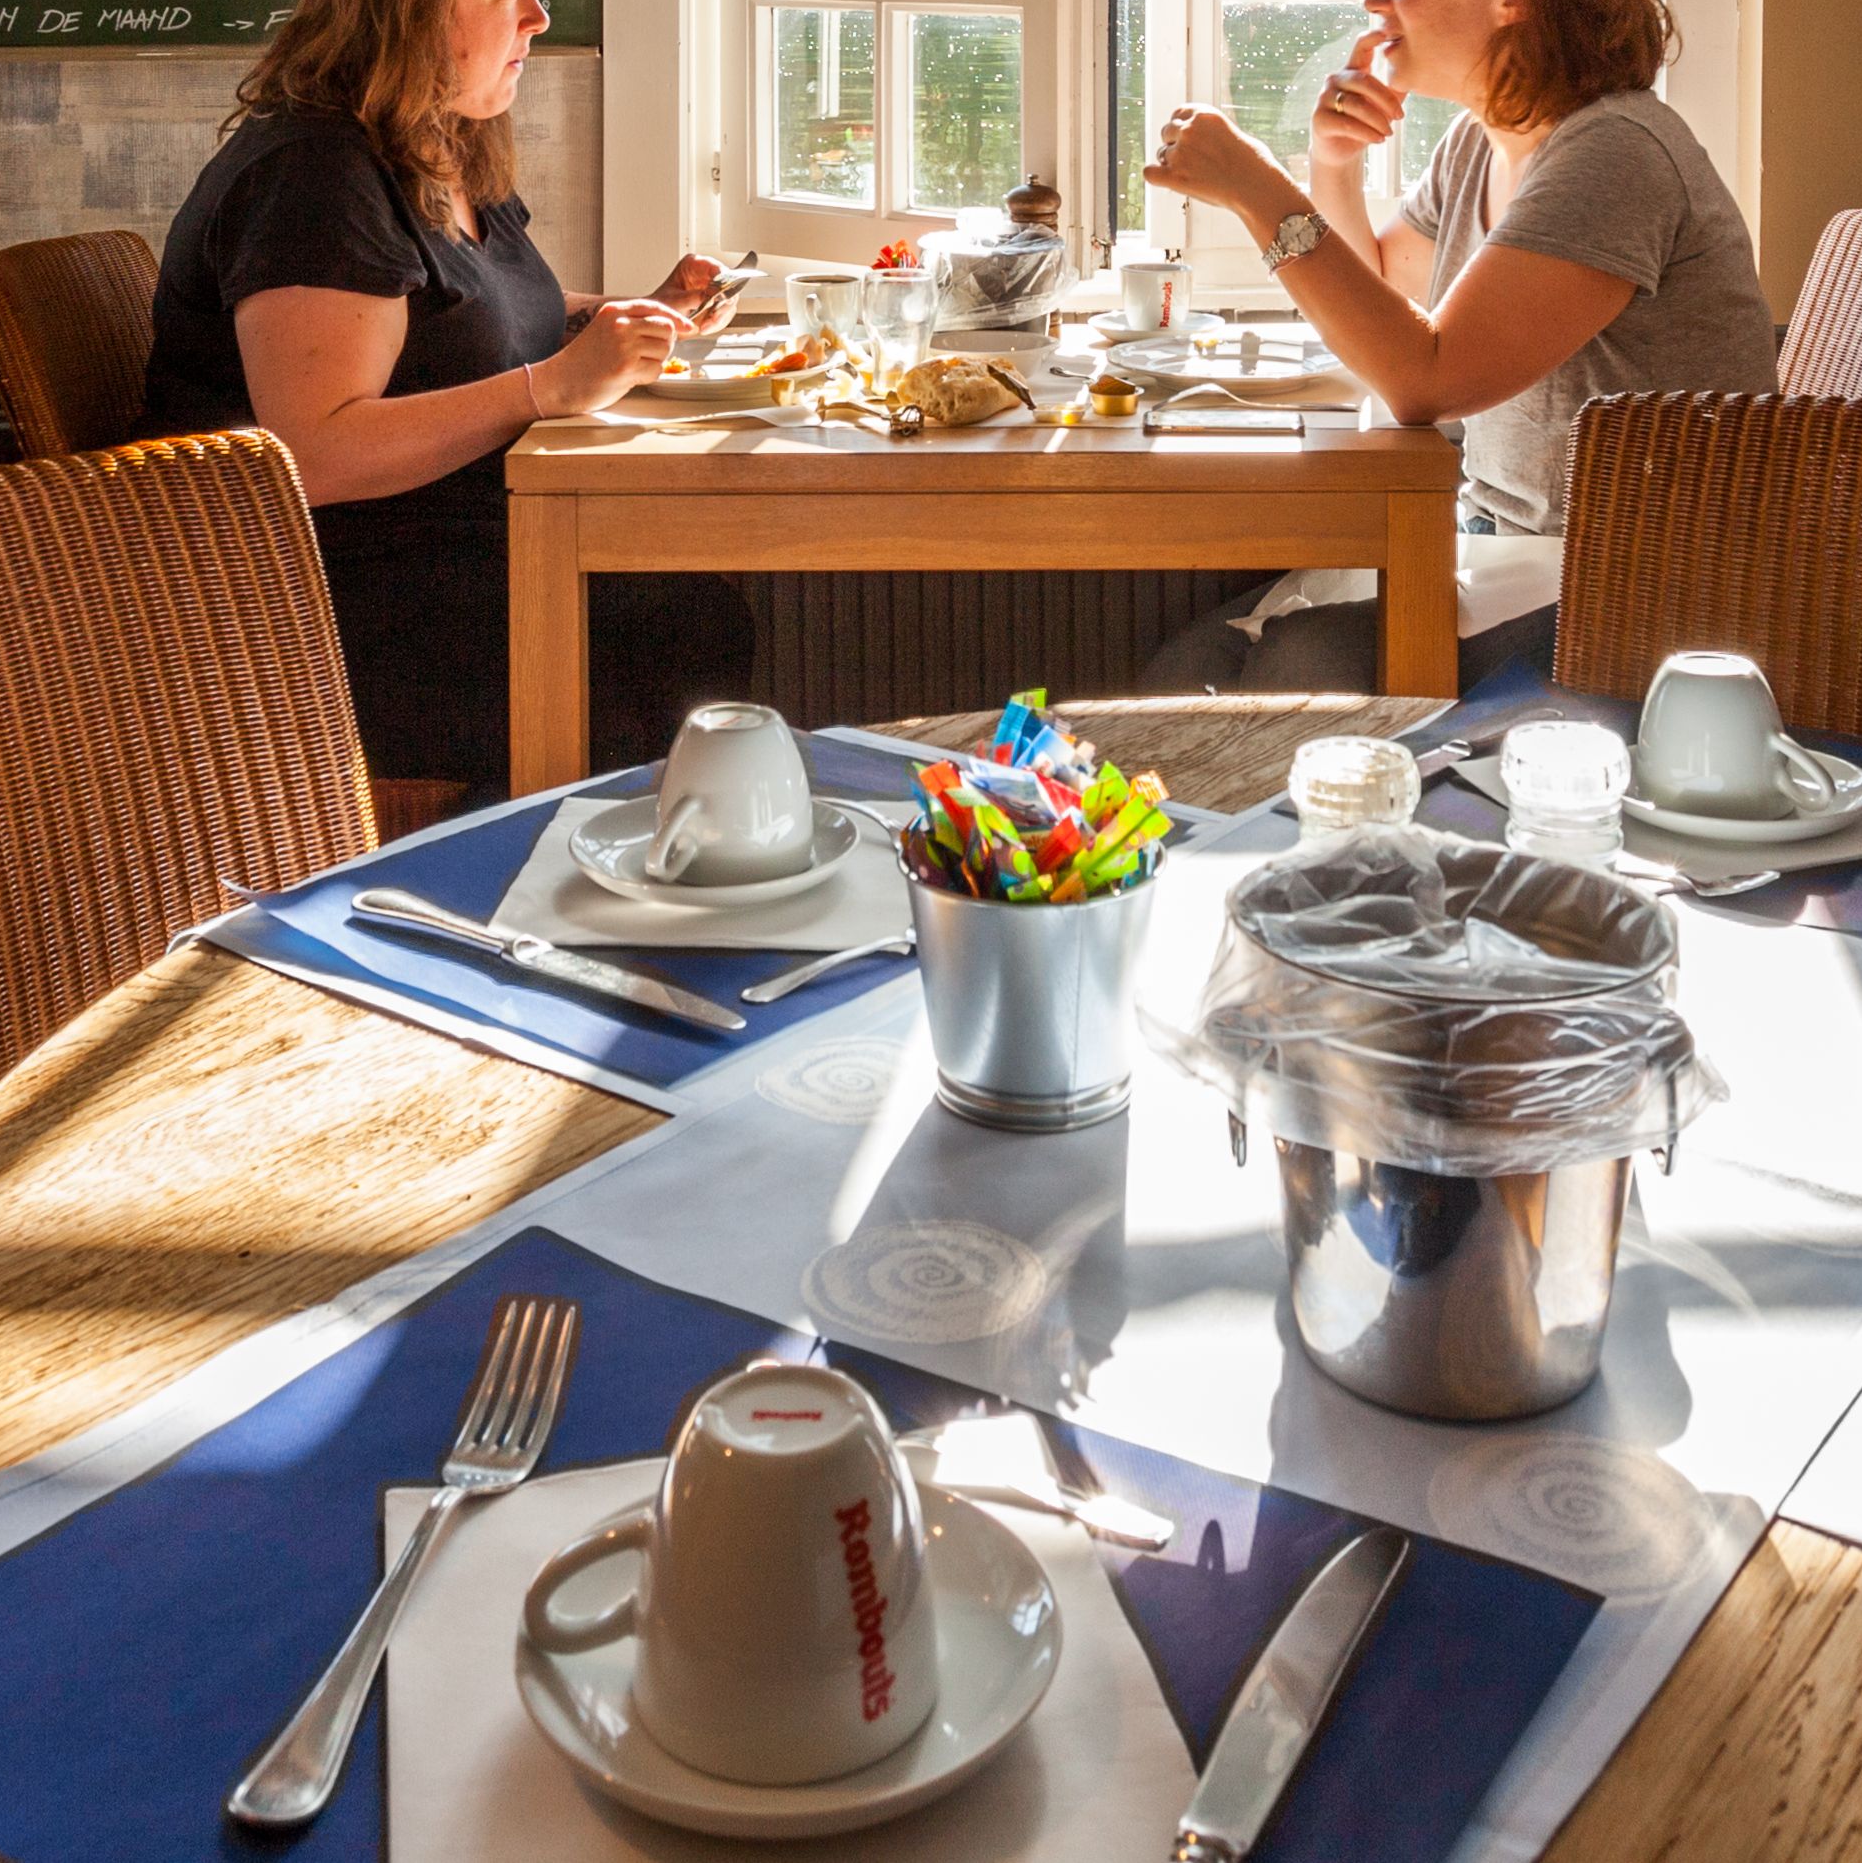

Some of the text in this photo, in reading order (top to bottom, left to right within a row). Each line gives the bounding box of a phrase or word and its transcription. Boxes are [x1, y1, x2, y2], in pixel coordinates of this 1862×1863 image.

[37, 9, 83, 33] DE
[97, 6, 191, 31] MAAND
[833, 1497, 897, 1723] Rombouts
